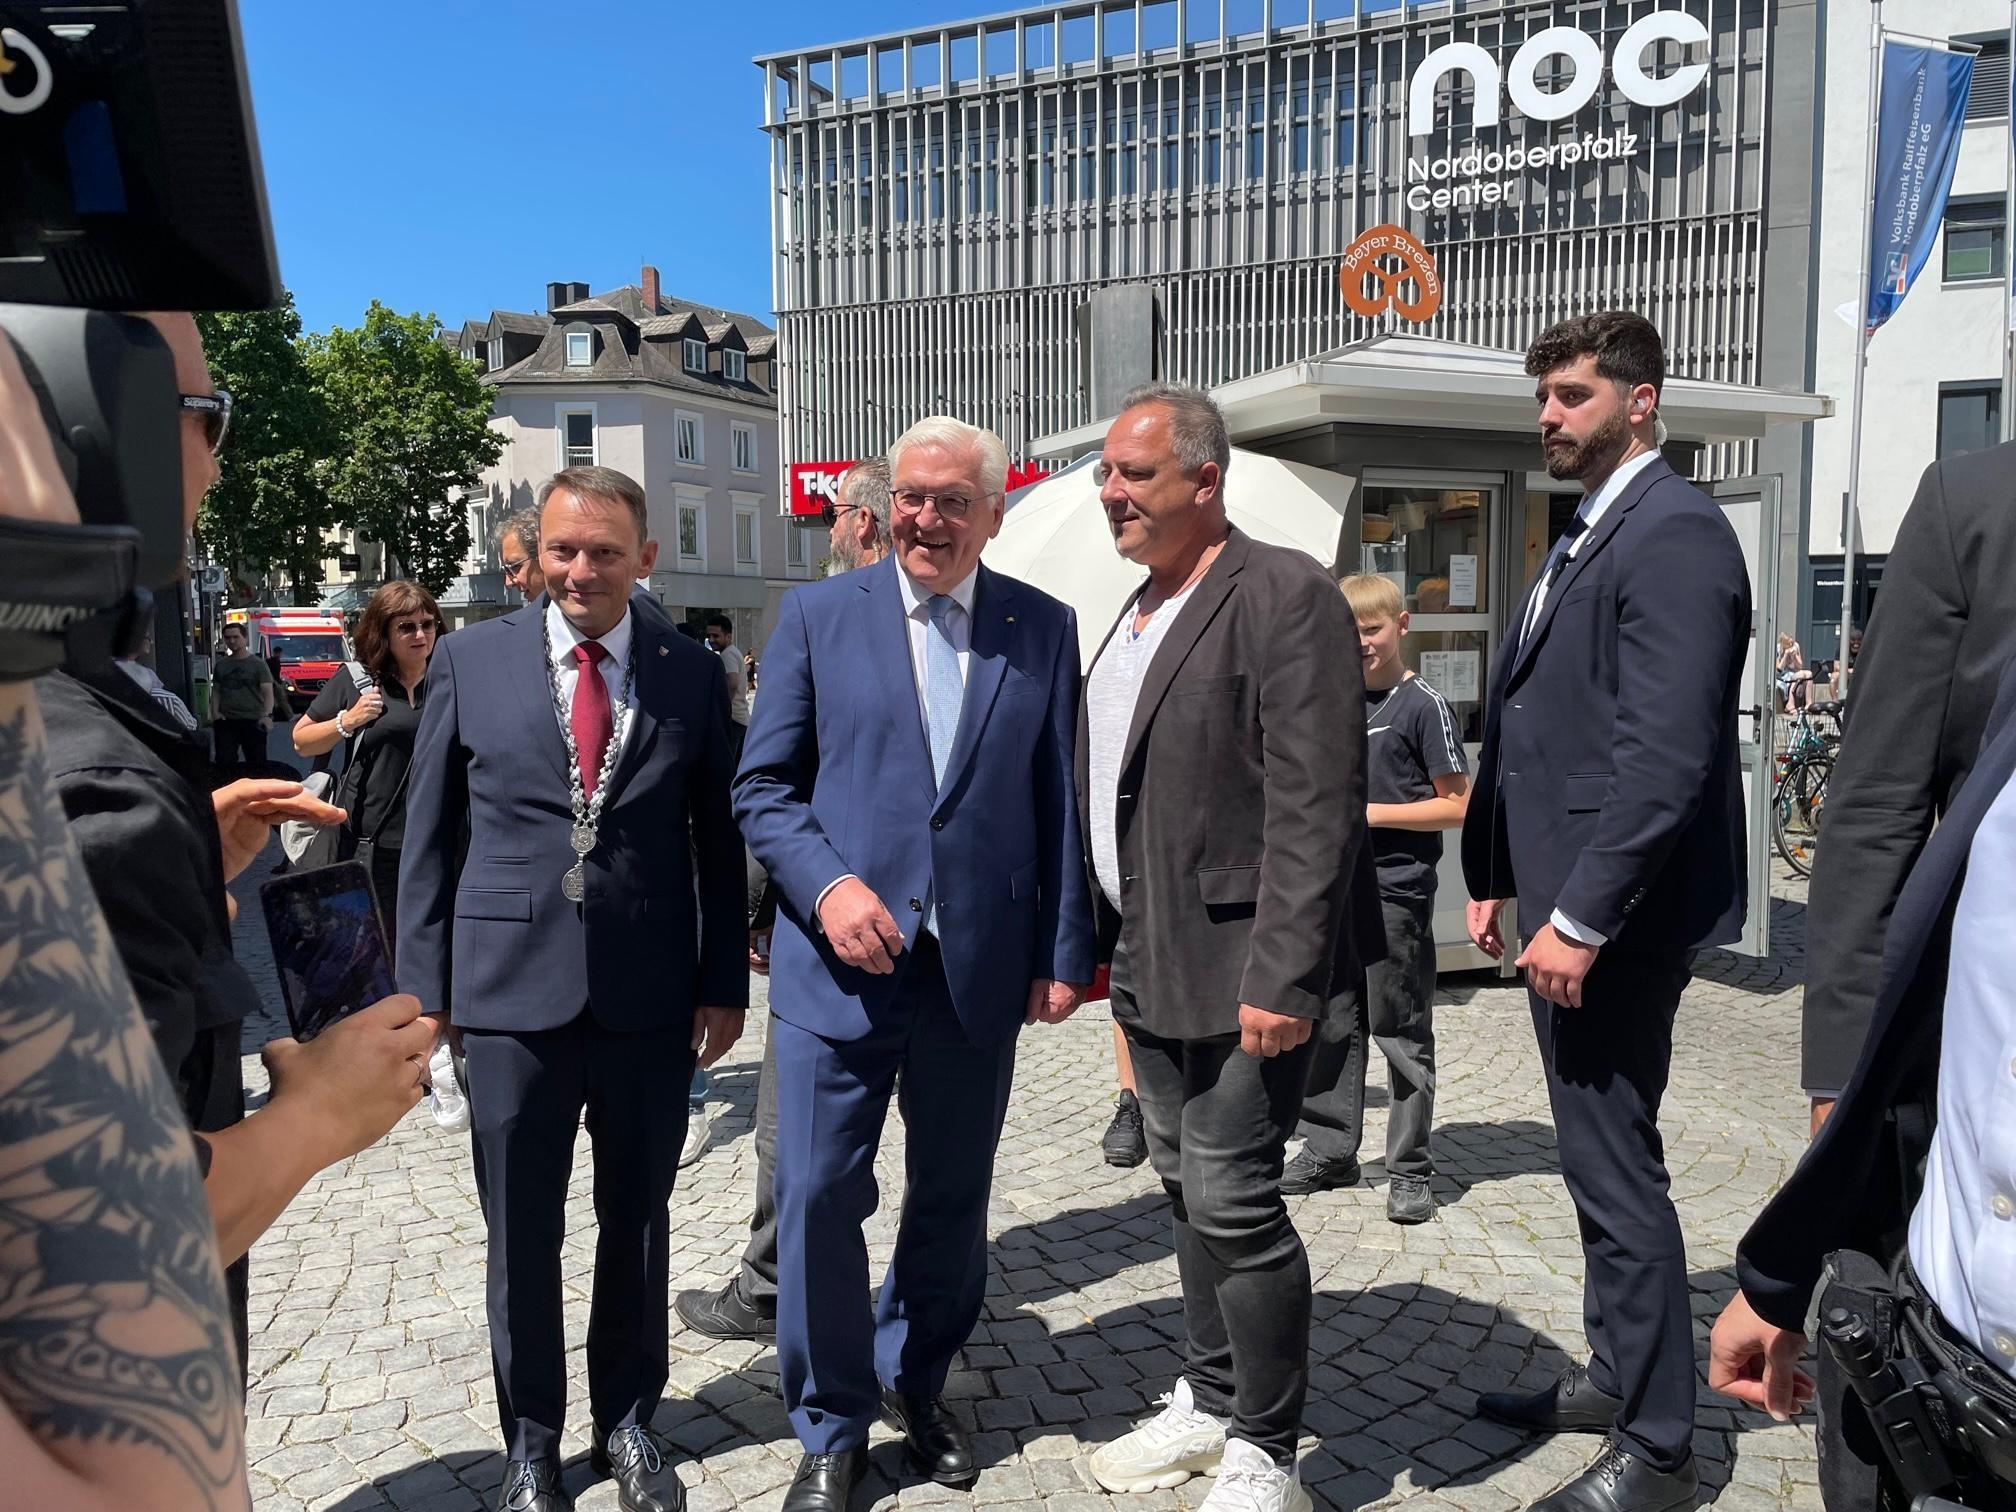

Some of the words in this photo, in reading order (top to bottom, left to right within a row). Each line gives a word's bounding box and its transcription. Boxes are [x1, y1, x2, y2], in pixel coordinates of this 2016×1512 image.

[1409, 10, 1709, 137] noc
[1407, 130, 1638, 183] Nordoberpfalz
[1407, 178, 1514, 212] Center
[1890, 174, 1910, 244] Volksbank
[1902, 67, 1926, 171] Raiffeisenbank
[1902, 145, 1928, 245] Nordoberpfalz
[1921, 123, 1931, 142] eG
[1345, 236, 1389, 272] Beyer
[1392, 235, 1438, 296] Brezen
